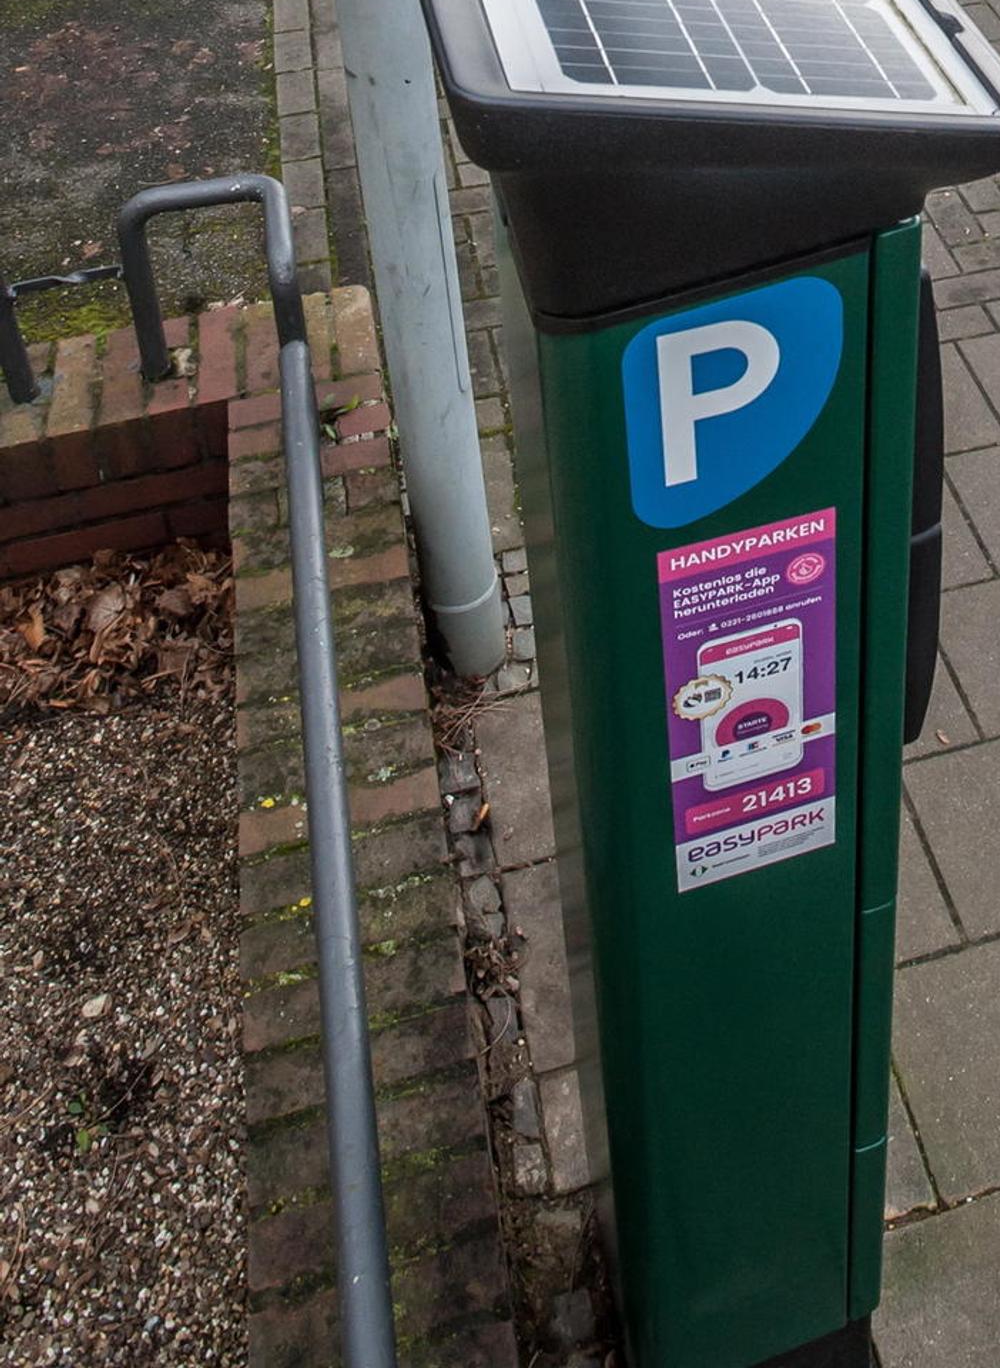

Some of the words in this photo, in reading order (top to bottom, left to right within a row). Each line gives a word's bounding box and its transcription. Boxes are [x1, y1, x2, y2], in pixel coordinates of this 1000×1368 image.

[656, 319, 780, 487] P
[670, 518, 825, 571] HANDYPARKEN
[672, 573, 742, 599] Kostenlos
[744, 566, 768, 579] die
[673, 574, 780, 610] EASYPARK-App
[673, 585, 775, 620] herunterladen
[734, 656, 793, 684] 14:27
[742, 777, 812, 813] 21413
